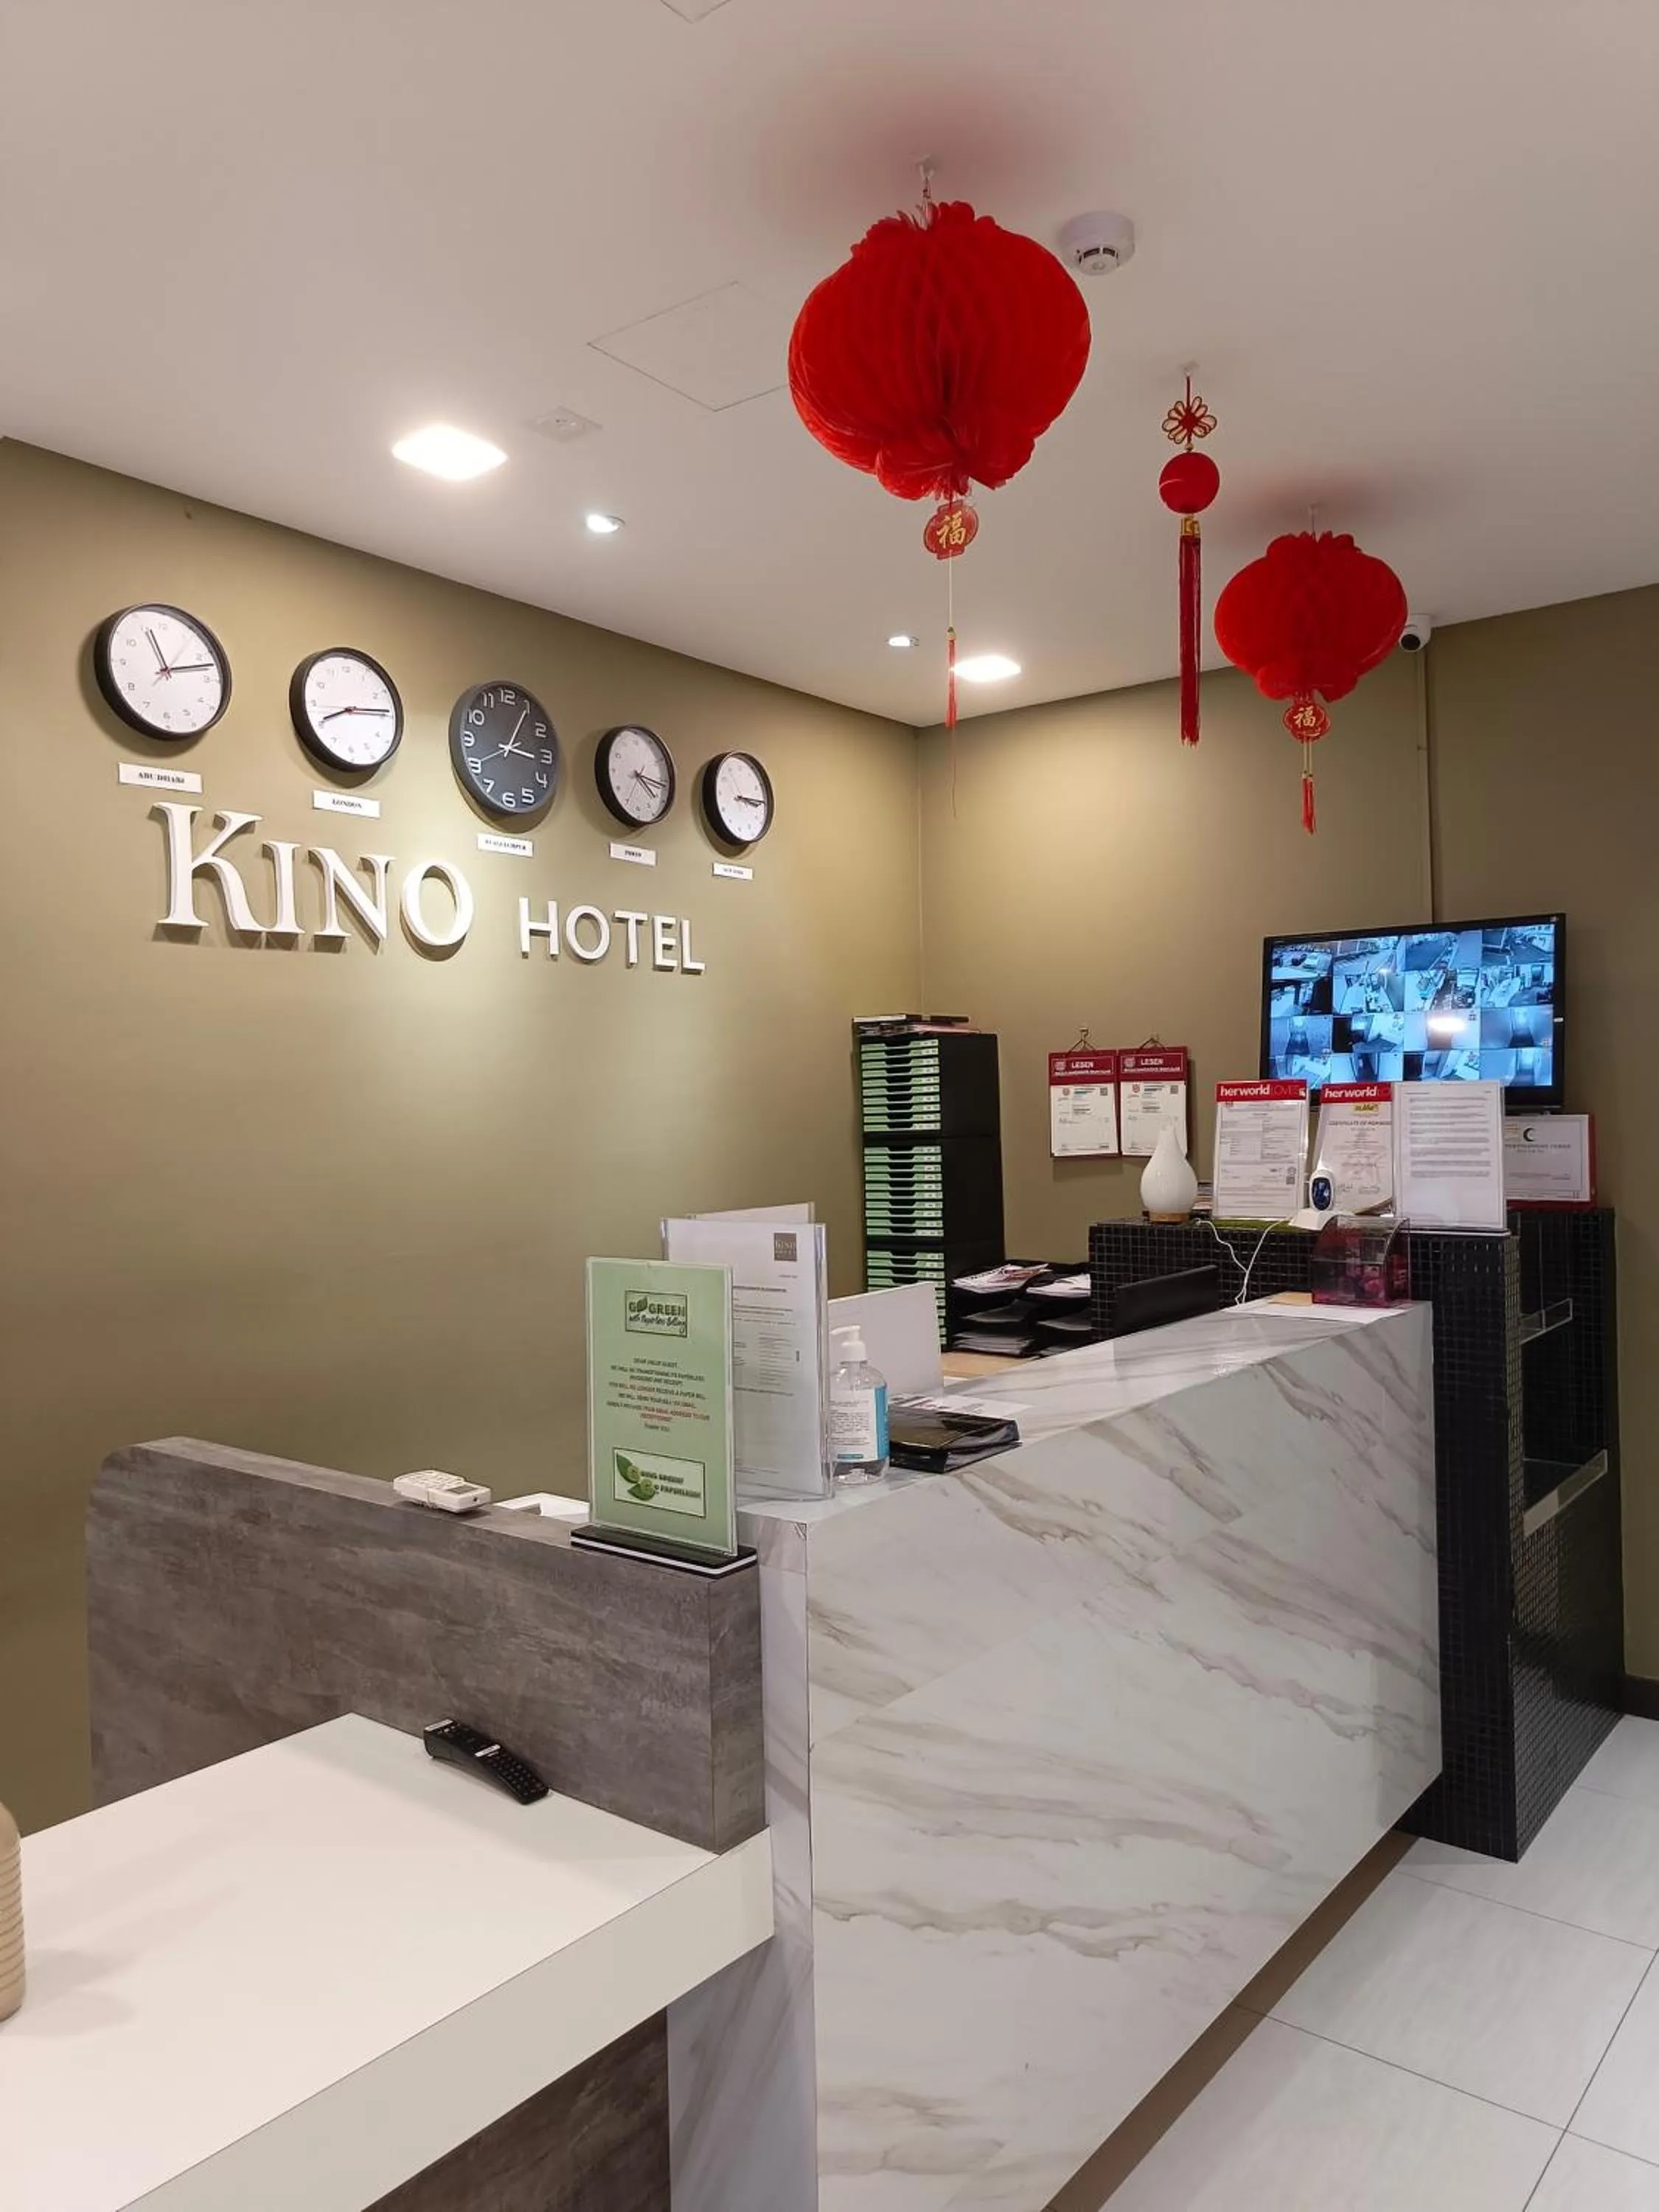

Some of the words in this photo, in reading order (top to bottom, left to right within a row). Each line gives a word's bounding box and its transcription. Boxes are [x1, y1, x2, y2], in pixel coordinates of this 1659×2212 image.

[936, 510, 967, 549] 福
[483, 692, 495, 709] 11
[500, 689, 516, 706] 12
[467, 709, 485, 726] 10
[1293, 705, 1316, 728] 福
[535, 722, 547, 738] 2
[464, 731, 476, 747] 9
[540, 748, 553, 765] 3
[467, 757, 481, 773] 8
[483, 778, 495, 793] 7
[535, 771, 548, 788] 4
[502, 792, 516, 808] 6
[521, 787, 535, 804] 5
[332, 799, 363, 809] LONDON
[149, 801, 474, 948] KINO
[519, 897, 706, 973] HOTEL
[1071, 1061, 1094, 1069] LESEN
[1141, 1057, 1164, 1065] LESEN
[648, 1302, 685, 1318] GREEN
